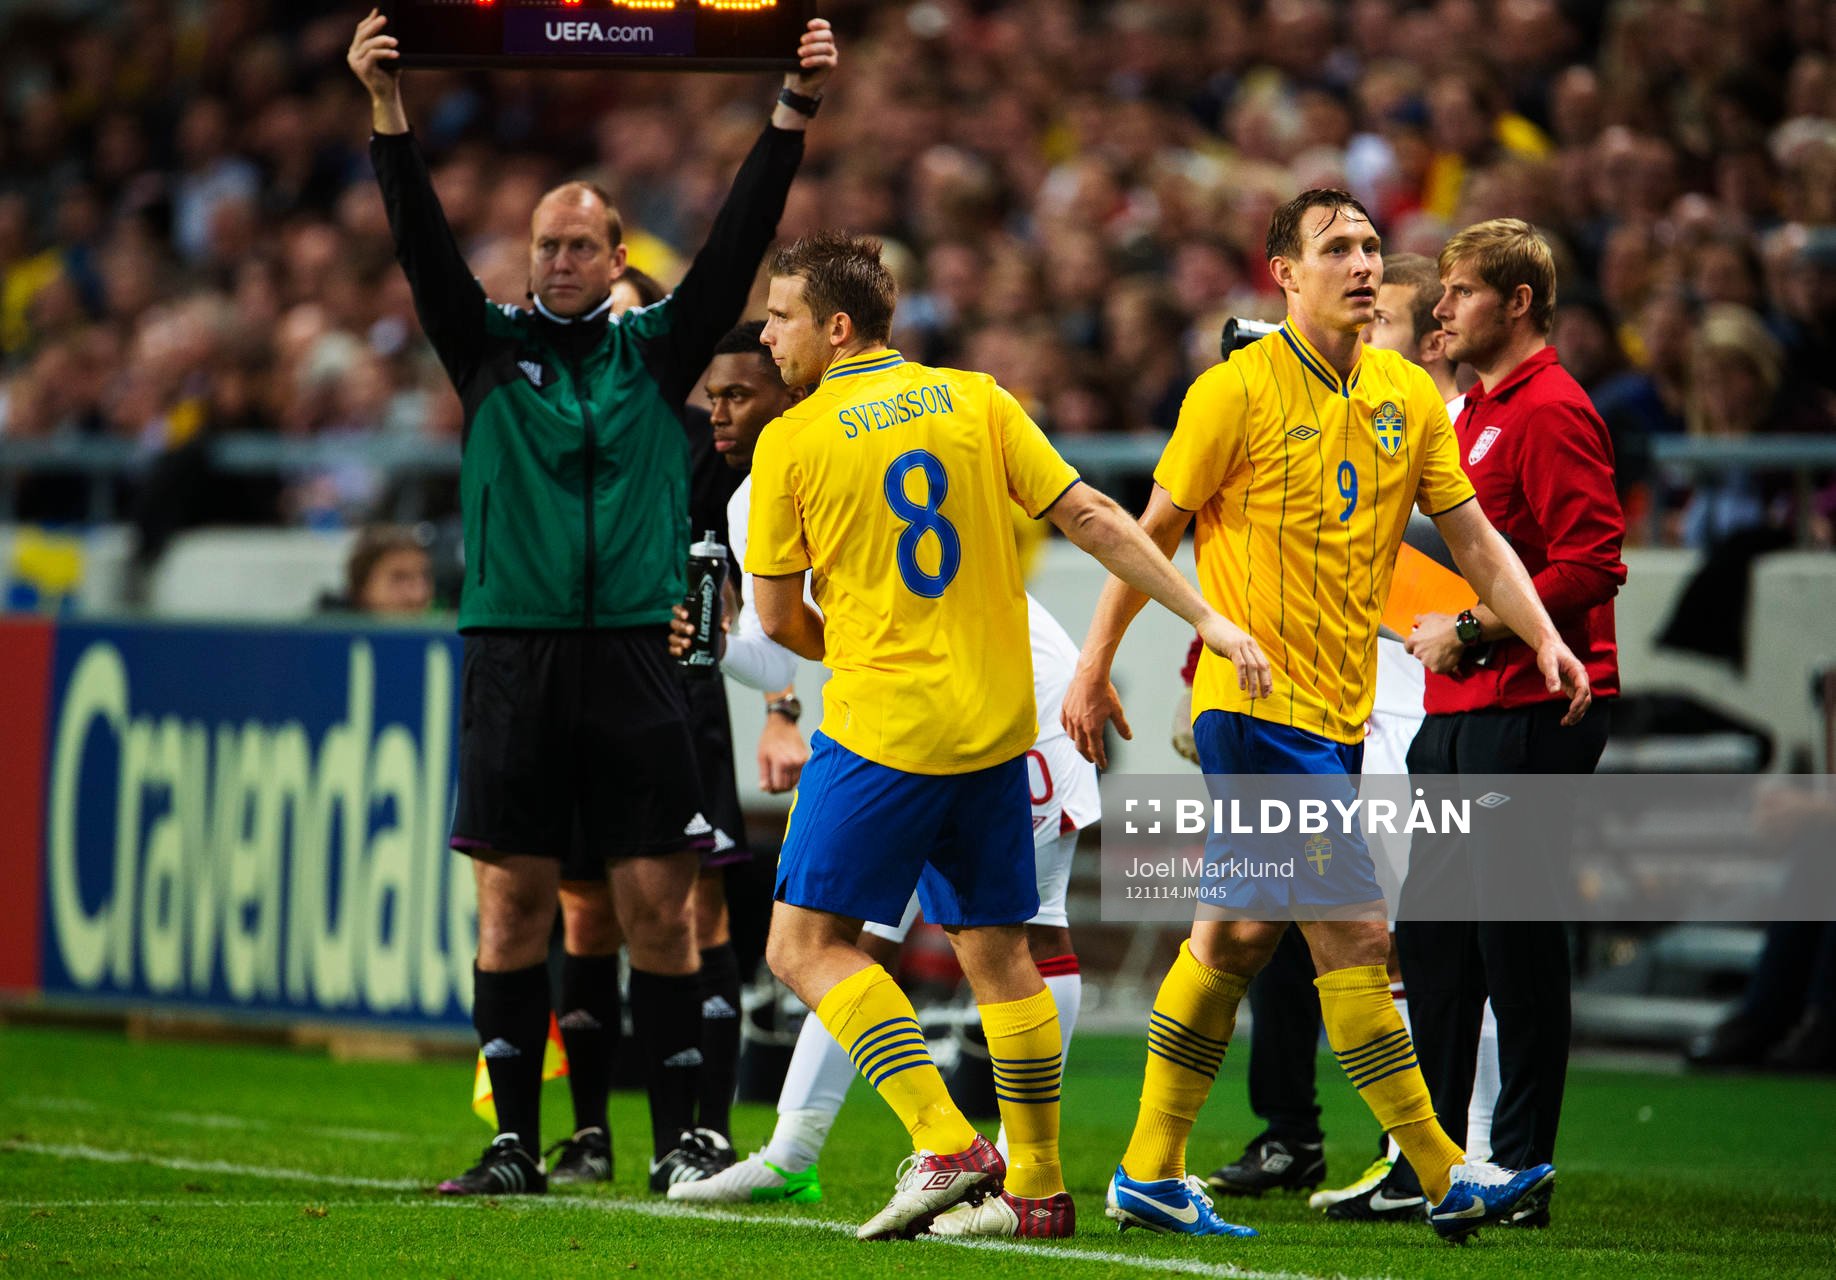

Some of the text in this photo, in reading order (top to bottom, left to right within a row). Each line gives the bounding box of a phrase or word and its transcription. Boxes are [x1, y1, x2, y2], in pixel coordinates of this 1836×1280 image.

[544, 21, 655, 42] UEFA.com
[838, 384, 954, 439] SVENSSON
[1337, 460, 1358, 523] 9
[884, 449, 961, 598] 8
